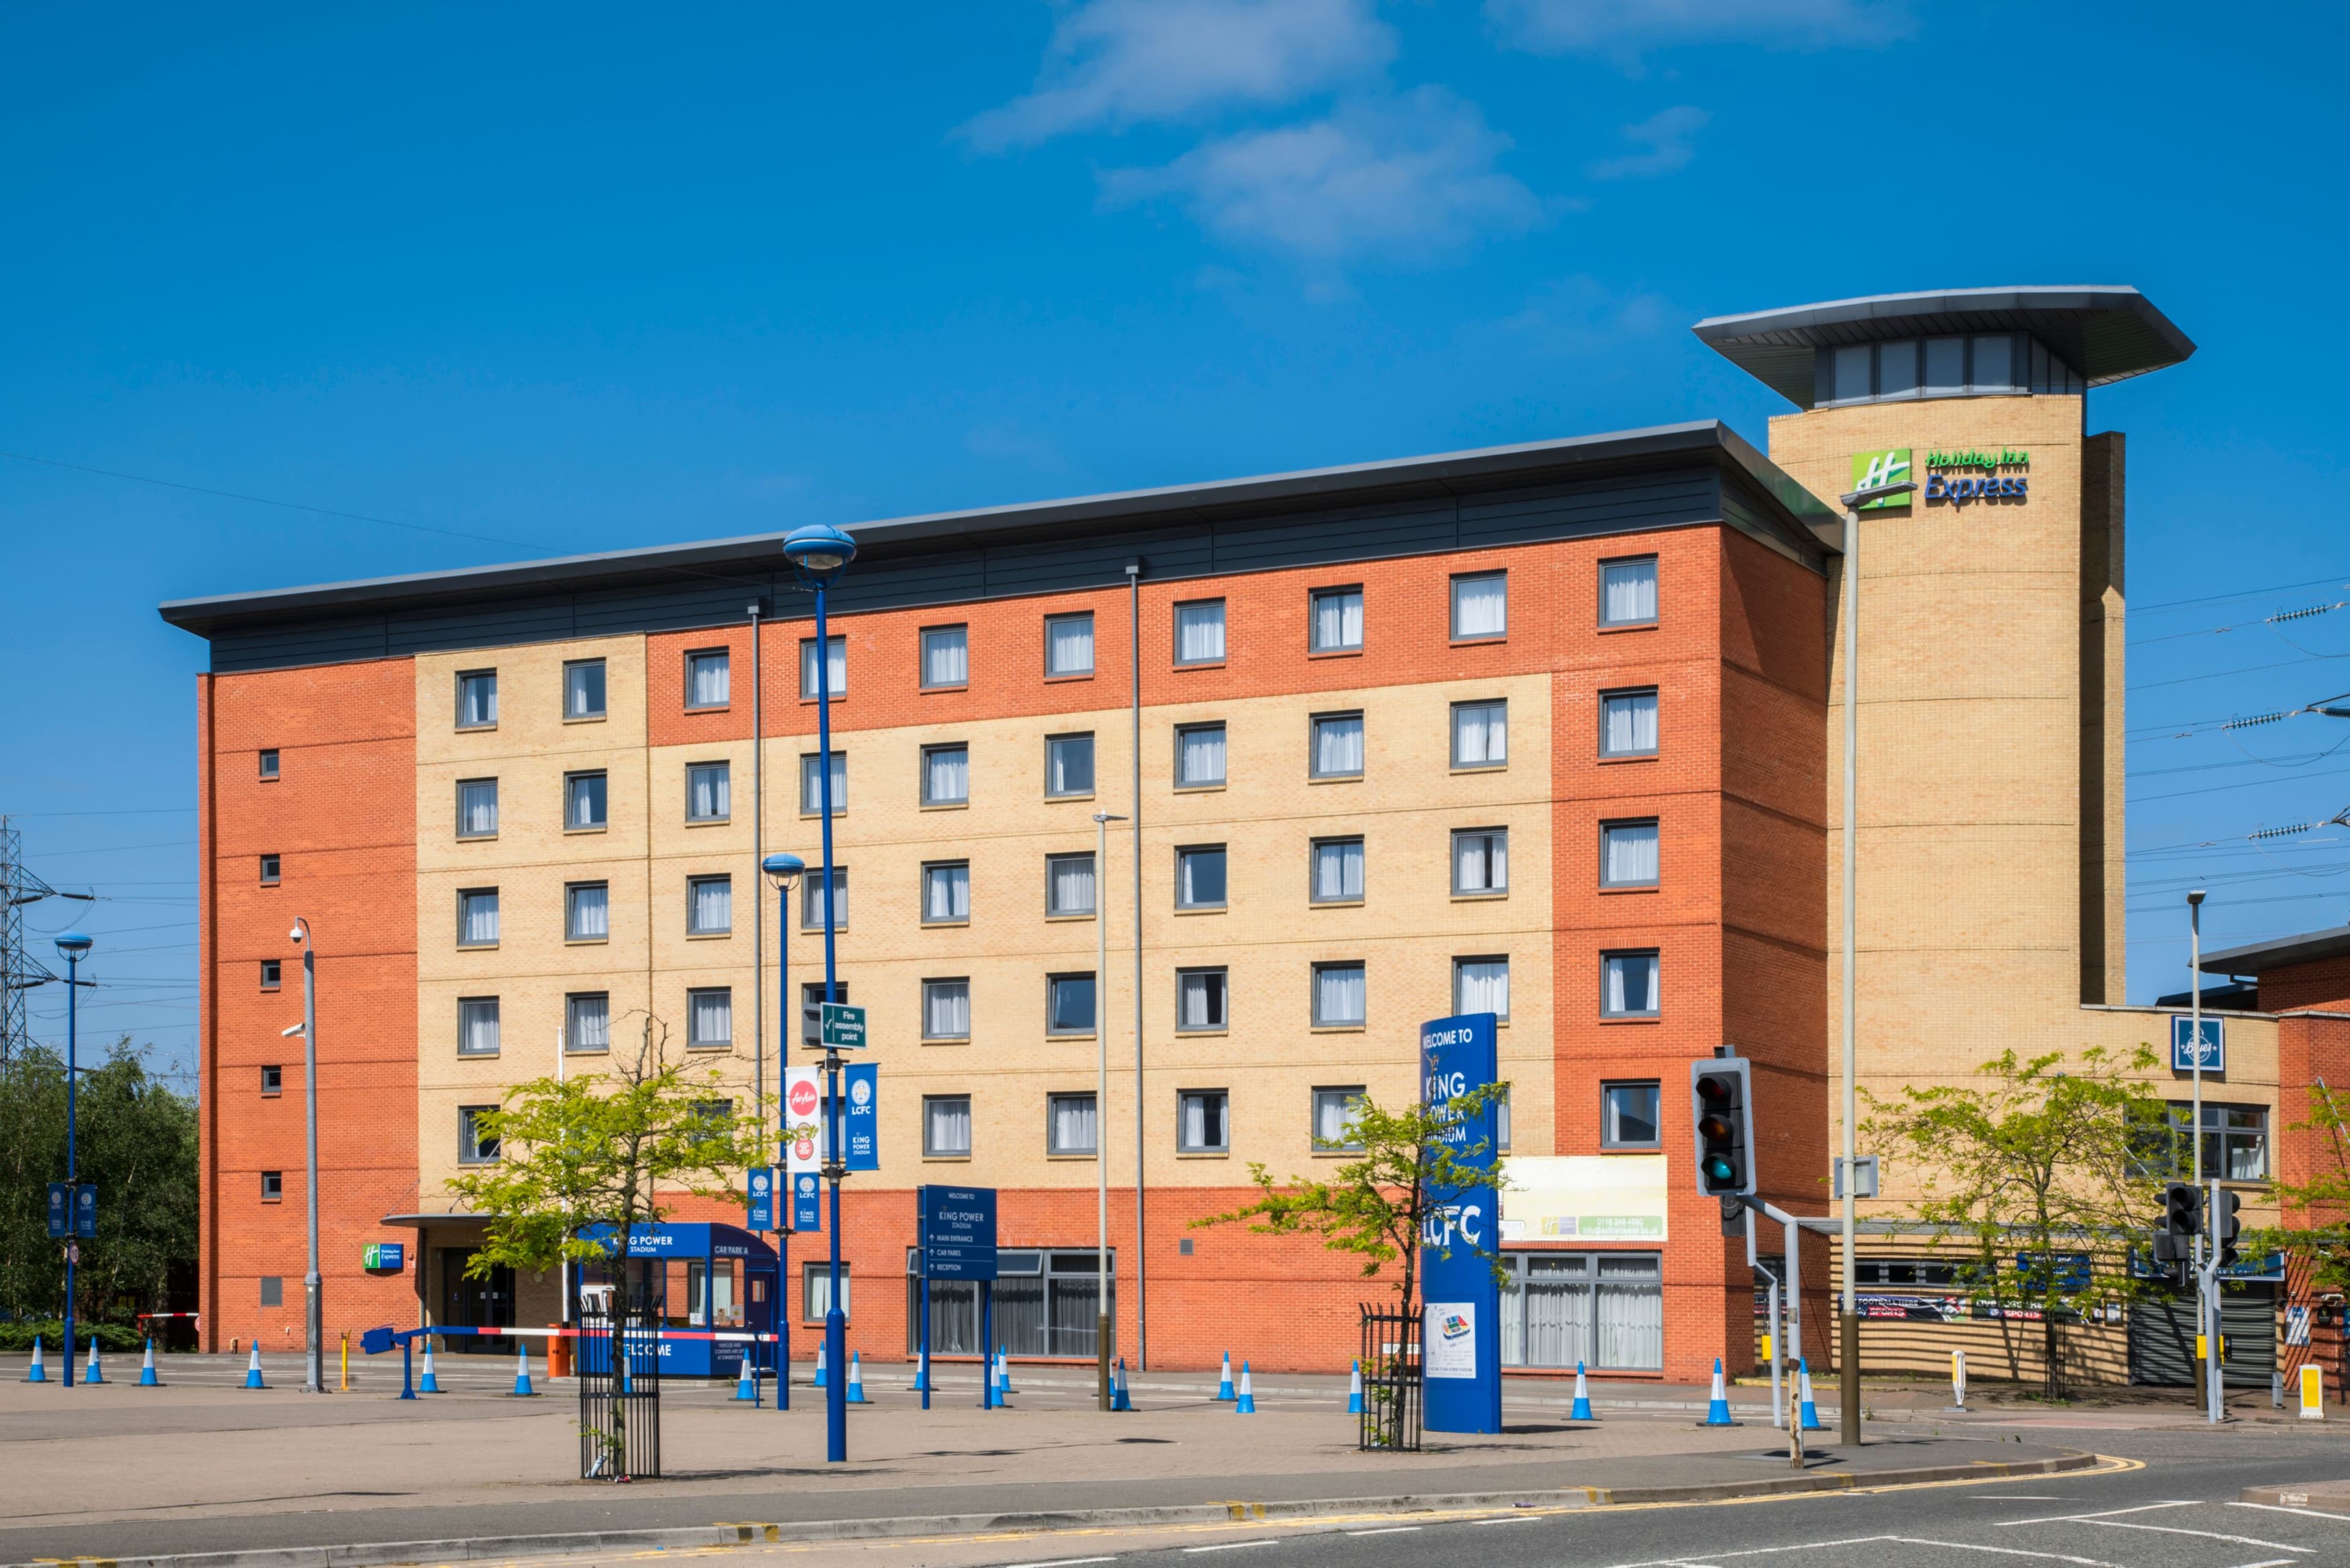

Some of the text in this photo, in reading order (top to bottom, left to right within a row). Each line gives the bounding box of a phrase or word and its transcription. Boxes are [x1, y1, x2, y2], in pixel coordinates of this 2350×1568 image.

[1925, 446, 2029, 469] Holiday Inn
[1924, 474, 2027, 504] Express
[843, 1010, 856, 1021] Fire
[834, 1021, 864, 1033] assembly
[841, 1032, 858, 1042] point
[1423, 1028, 1473, 1050] WELCOME TO
[1426, 1072, 1466, 1101] KING
[851, 1105, 871, 1115] LCFC
[1426, 1103, 1465, 1124] OWER
[939, 1211, 983, 1222] KING POWER
[1423, 1204, 1482, 1246] LCFC
[613, 1236, 673, 1245] KG POWER
[714, 1245, 727, 1254] CAR
[728, 1246, 742, 1255] PARK
[1858, 1297, 1898, 1306] FOOTBALL
[1898, 1299, 1919, 1307] HERE
[1869, 1307, 1906, 1317] SPORTS
[2005, 1310, 2040, 1318] SPORTS
